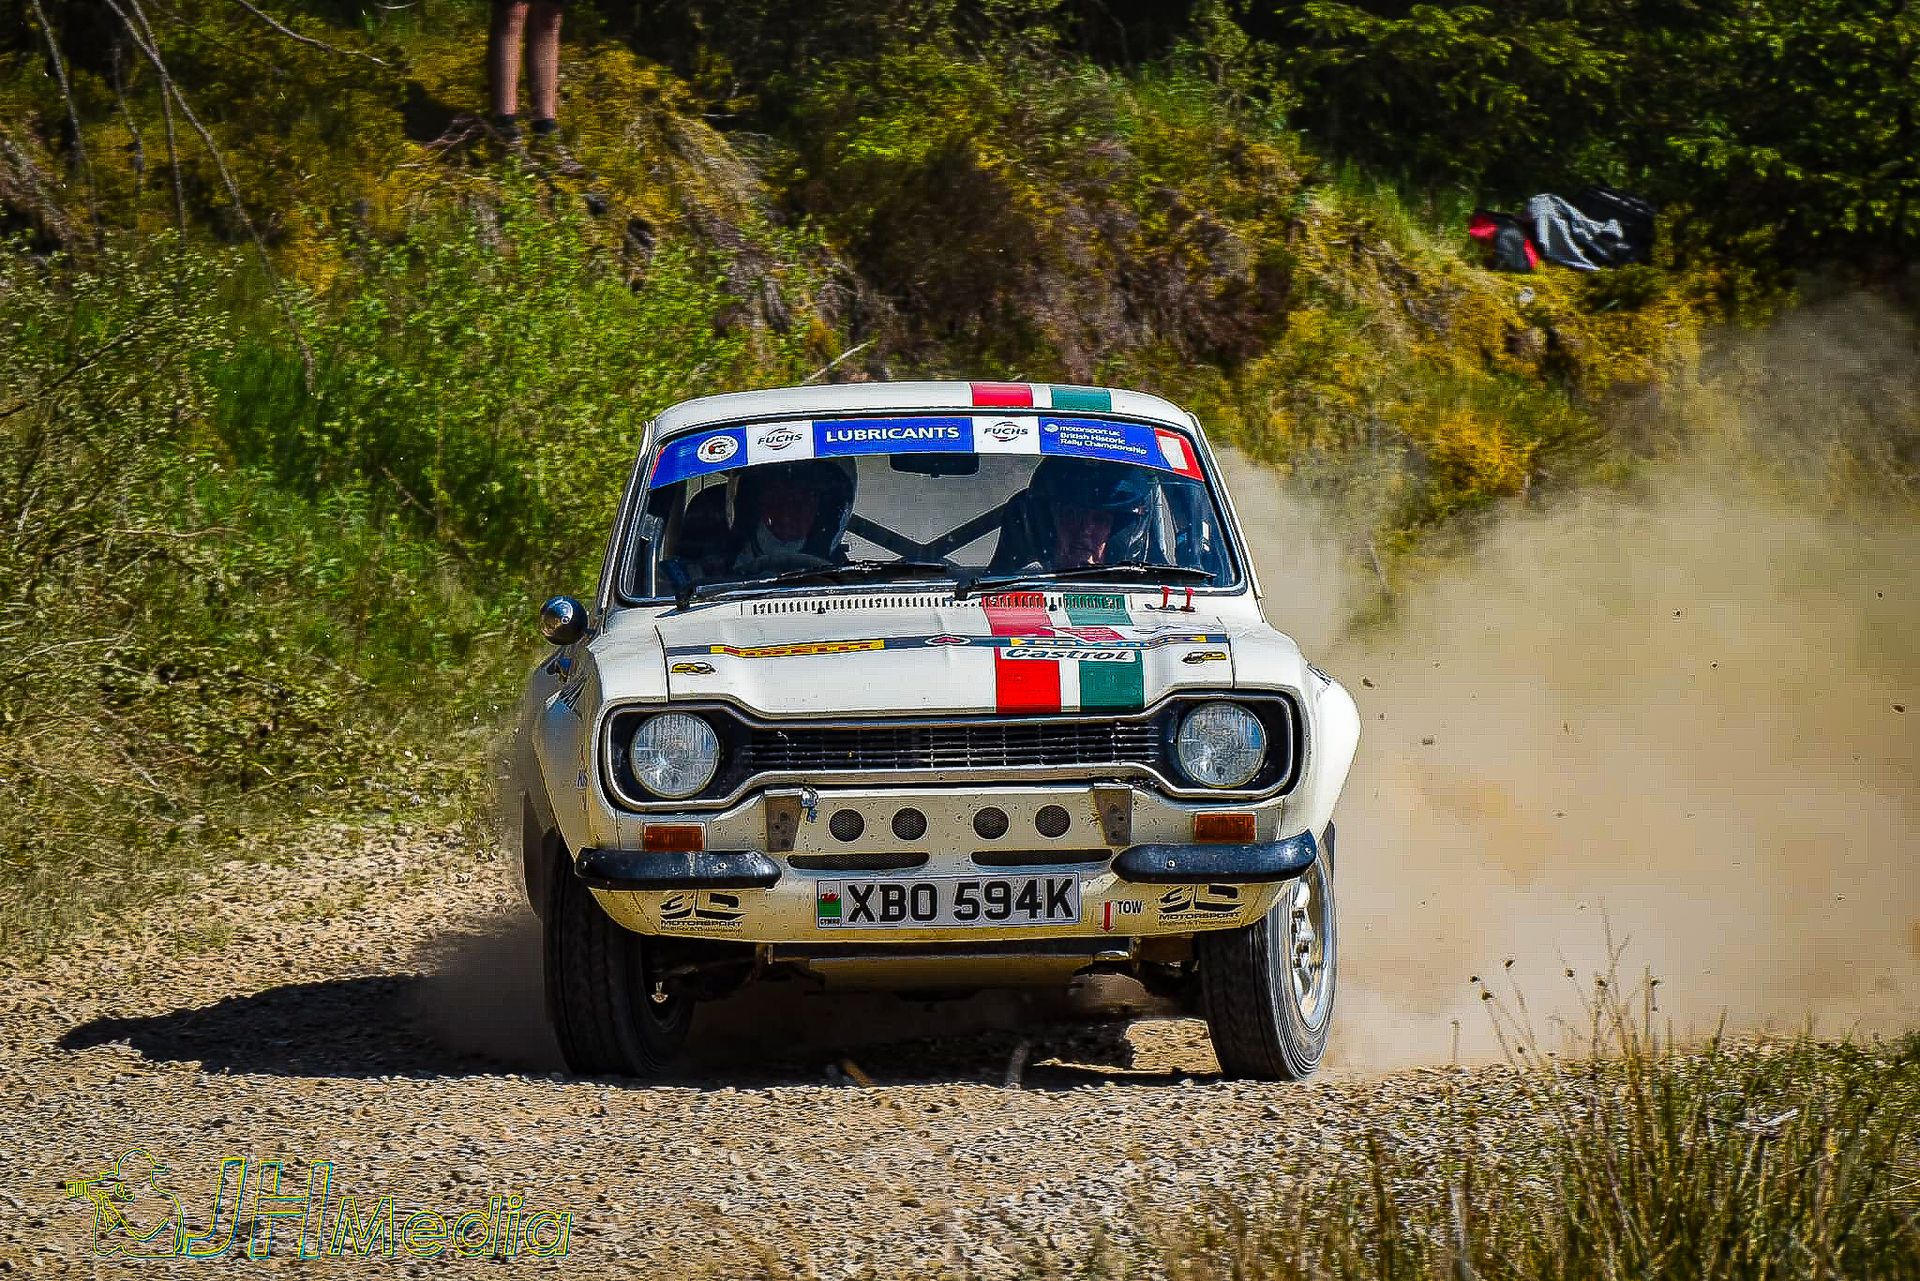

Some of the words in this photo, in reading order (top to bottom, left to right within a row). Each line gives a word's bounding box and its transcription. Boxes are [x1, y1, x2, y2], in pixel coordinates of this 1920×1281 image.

[826, 426, 960, 443] LUBRICANTS
[983, 426, 1029, 437] FUCHS
[1060, 432, 1089, 440] British
[1091, 434, 1126, 444] Historic
[757, 432, 803, 445] FUCHS
[1060, 438, 1083, 446] Rally
[1084, 440, 1147, 455] Championship
[1006, 648, 1131, 661] Castrol
[847, 883, 938, 923] XBO
[953, 878, 1074, 921] 594K
[1117, 900, 1143, 914] TOW
[1158, 911, 1242, 920] MOTORSPORT
